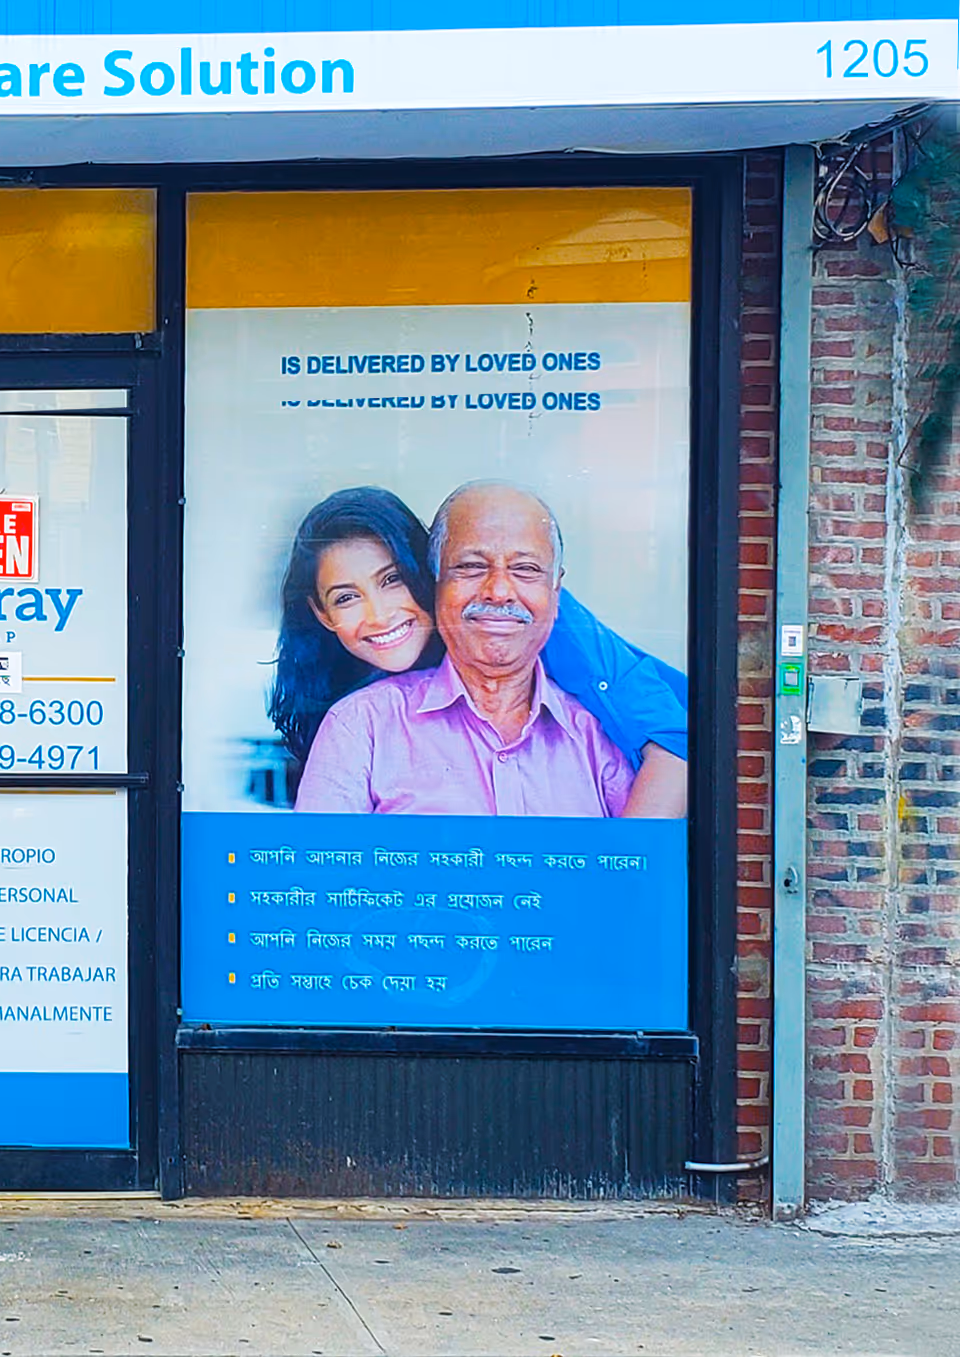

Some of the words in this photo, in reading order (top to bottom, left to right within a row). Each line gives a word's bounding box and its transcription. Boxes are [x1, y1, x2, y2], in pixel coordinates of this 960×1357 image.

[815, 39, 929, 78] 1205
[104, 47, 354, 96] Solution
[281, 356, 301, 375] IS
[307, 354, 426, 375] DELIVERED
[431, 353, 461, 373] BY
[465, 353, 537, 373] LOVED
[541, 351, 601, 372] ONES
[465, 392, 537, 410] LOVED
[541, 391, 601, 411] ONES
[11, 926, 91, 943] LICENCIA
[27, 965, 116, 983] TRABAJAR
